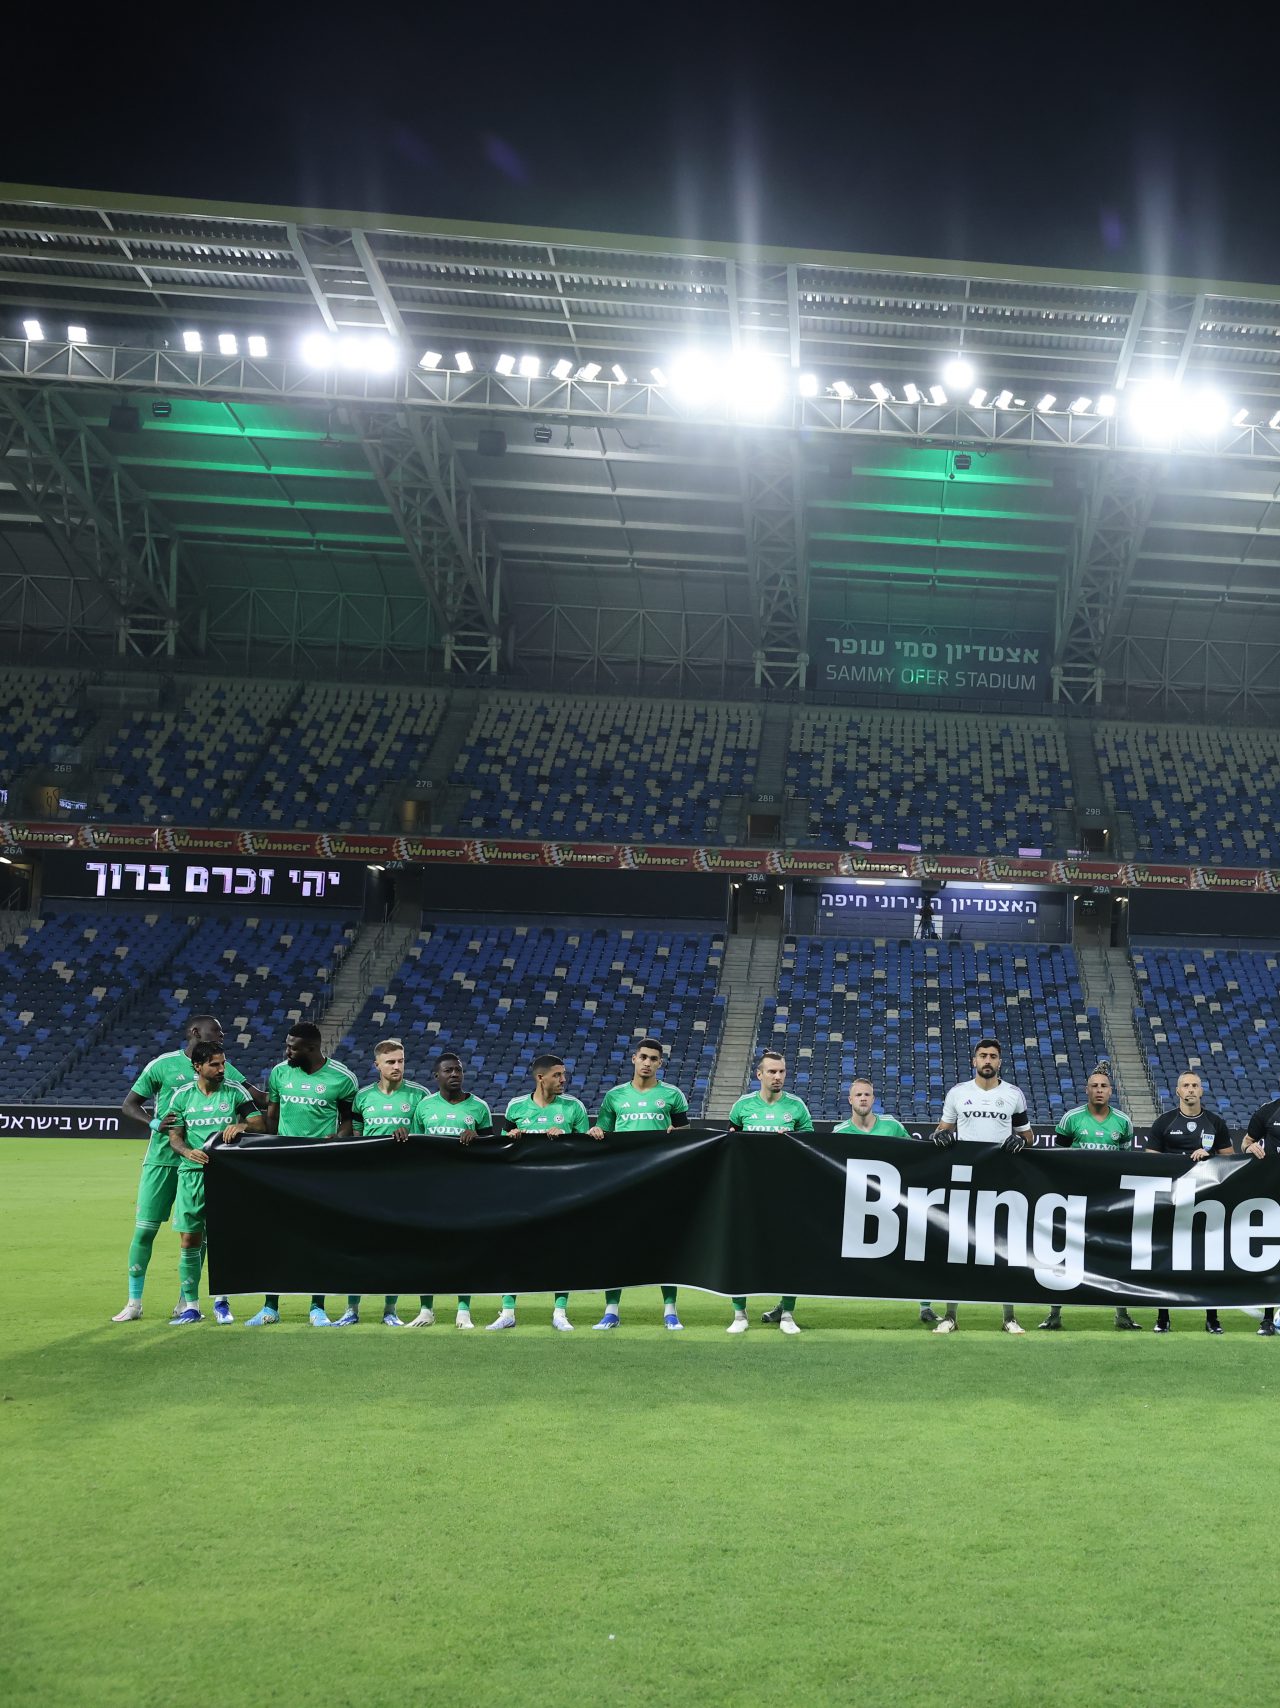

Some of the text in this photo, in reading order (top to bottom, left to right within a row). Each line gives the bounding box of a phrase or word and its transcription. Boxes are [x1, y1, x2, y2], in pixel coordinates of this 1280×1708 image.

[825, 637, 1039, 665] אצטדיון סמי עופר
[826, 664, 1036, 691] SAMMY OFER STADIUM
[11, 828, 73, 843] Winner
[92, 831, 153, 846] Winner
[173, 834, 232, 848] Winner
[3, 846, 23, 855] 26A
[252, 838, 310, 852] Winner
[330, 840, 387, 855] Winner
[407, 843, 464, 858] Winner
[484, 847, 540, 861] Winner
[559, 850, 614, 864] Winner
[633, 852, 688, 866] Winner
[385, 860, 403, 869] 27A
[707, 854, 761, 869] Winner
[779, 856, 834, 871] Winner
[852, 858, 906, 873] Winner
[924, 861, 977, 875] Winner
[747, 873, 765, 881] 28A
[995, 864, 1047, 878] Winner
[1065, 867, 1118, 881] Winner
[1135, 870, 1186, 884] Winner
[86, 862, 340, 897] יהי זכרם ברוך
[1203, 873, 1255, 887] Winner
[1093, 885, 1110, 894] 29A
[821, 893, 867, 908] חיפה
[951, 896, 1038, 914] האצטדיון
[280, 1094, 328, 1107] VOLVO
[0, 1113, 118, 1131] חדש בישראל
[185, 1116, 233, 1128] VOLVO
[365, 1117, 411, 1126] VOLVO
[620, 1112, 664, 1121] VOLVO
[962, 1110, 1007, 1121] VOLVO
[427, 1126, 465, 1136] VOLV
[1079, 1142, 1117, 1151] VOLVO
[841, 1158, 1087, 1291] Bring
